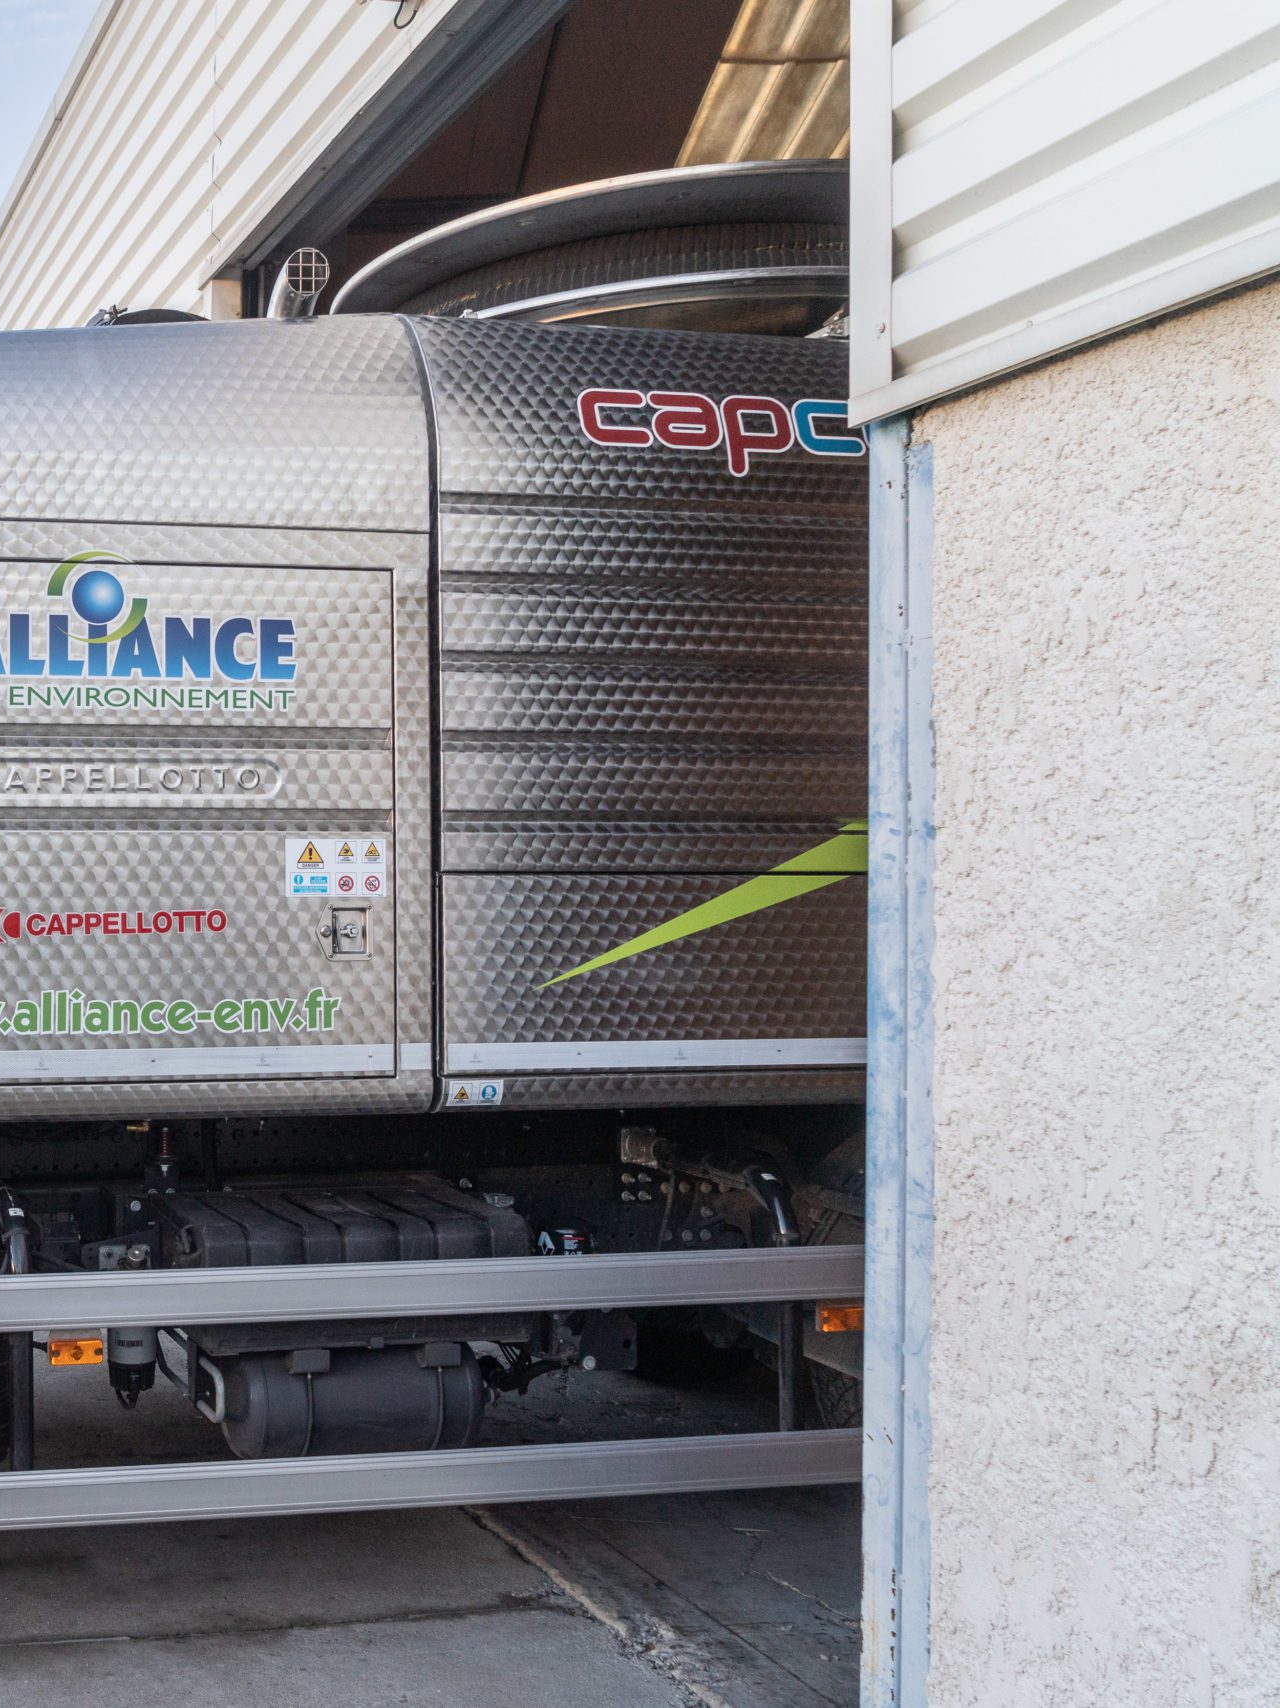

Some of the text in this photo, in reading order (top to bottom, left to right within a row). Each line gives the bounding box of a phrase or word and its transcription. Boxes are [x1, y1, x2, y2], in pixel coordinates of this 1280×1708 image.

[577, 387, 871, 477] capc
[8, 685, 296, 711] ENVIRONNEMENT
[26, 909, 227, 937] CAPPELLOTTO
